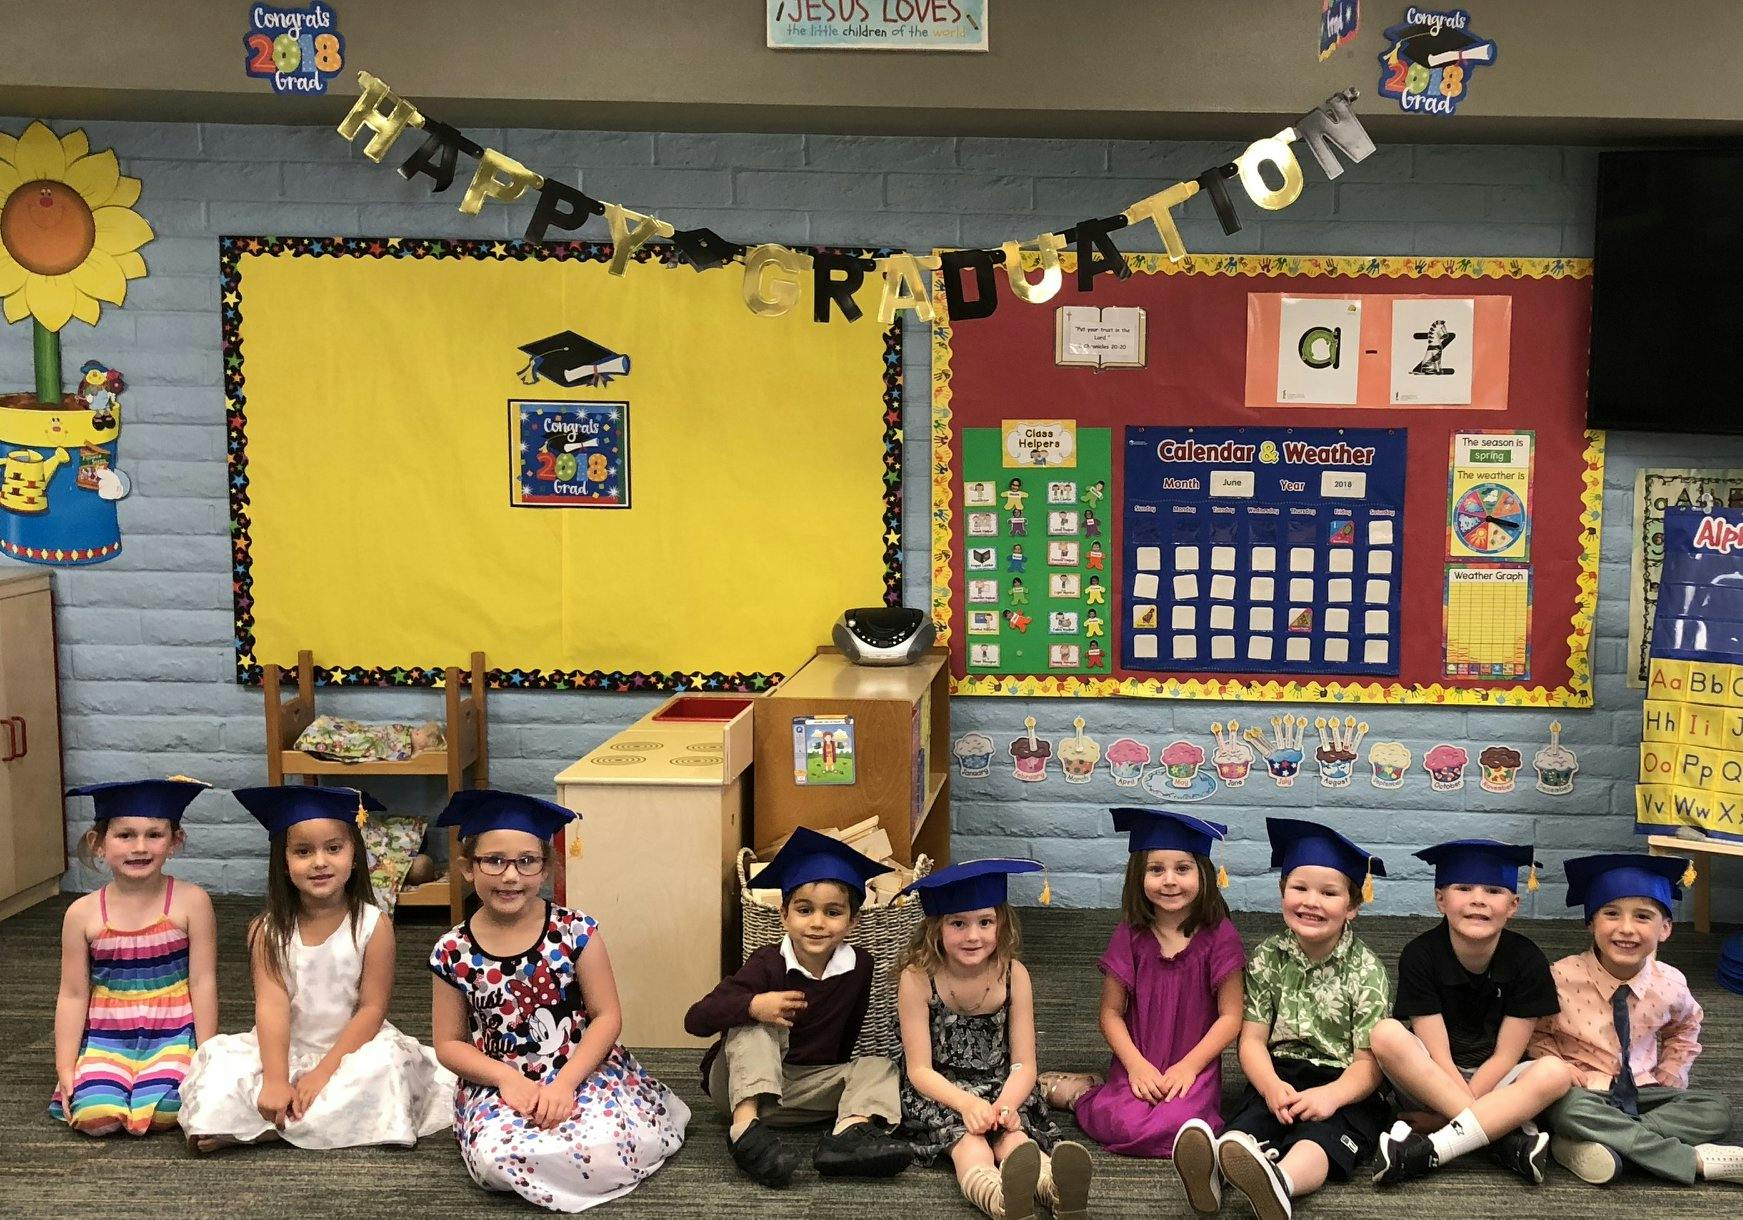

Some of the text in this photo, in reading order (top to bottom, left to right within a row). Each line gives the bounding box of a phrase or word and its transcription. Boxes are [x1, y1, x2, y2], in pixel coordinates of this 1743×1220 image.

[788, 0, 962, 23] JESUS LOVES
[254, 5, 330, 41] Congrats
[786, 24, 966, 38] the little children of the world
[1406, 7, 1467, 37] Congrats
[248, 33, 343, 73] 2018
[275, 70, 323, 92] Grad
[1385, 60, 1464, 97] 2018
[1402, 88, 1454, 114] Grad
[335, 71, 1377, 323] HAPPY GRADUATION
[1298, 326, 1341, 370] a
[544, 418, 600, 442] Congrats
[1026, 429, 1054, 438] Class
[1019, 439, 1060, 450] Helpers
[1462, 437, 1524, 447] The season is
[1157, 439, 1376, 466] Calendar & Weather
[1475, 451, 1504, 462] spring
[536, 452, 608, 482] 2018
[1457, 470, 1525, 480] The weather is
[554, 480, 589, 496] Grad
[1163, 477, 1242, 491] Month June
[1279, 480, 1352, 492] Year 2018
[1454, 571, 1524, 582] Weather Graph
[1651, 668, 1682, 691] Aa
[1690, 671, 1723, 694] Bb
[1646, 710, 1675, 732] Hh
[961, 768, 989, 776] January
[1068, 775, 1090, 783] March
[1683, 753, 1713, 786] Pp
[1118, 778, 1135, 786] April
[1174, 779, 1189, 787] May
[1323, 778, 1348, 787] August
[1434, 780, 1461, 790] October
[1482, 780, 1514, 791] November
[1537, 783, 1572, 793] December
[1643, 794, 1664, 814] Vv
[1674, 794, 1710, 820] Ww
[468, 987, 506, 1012] Just
